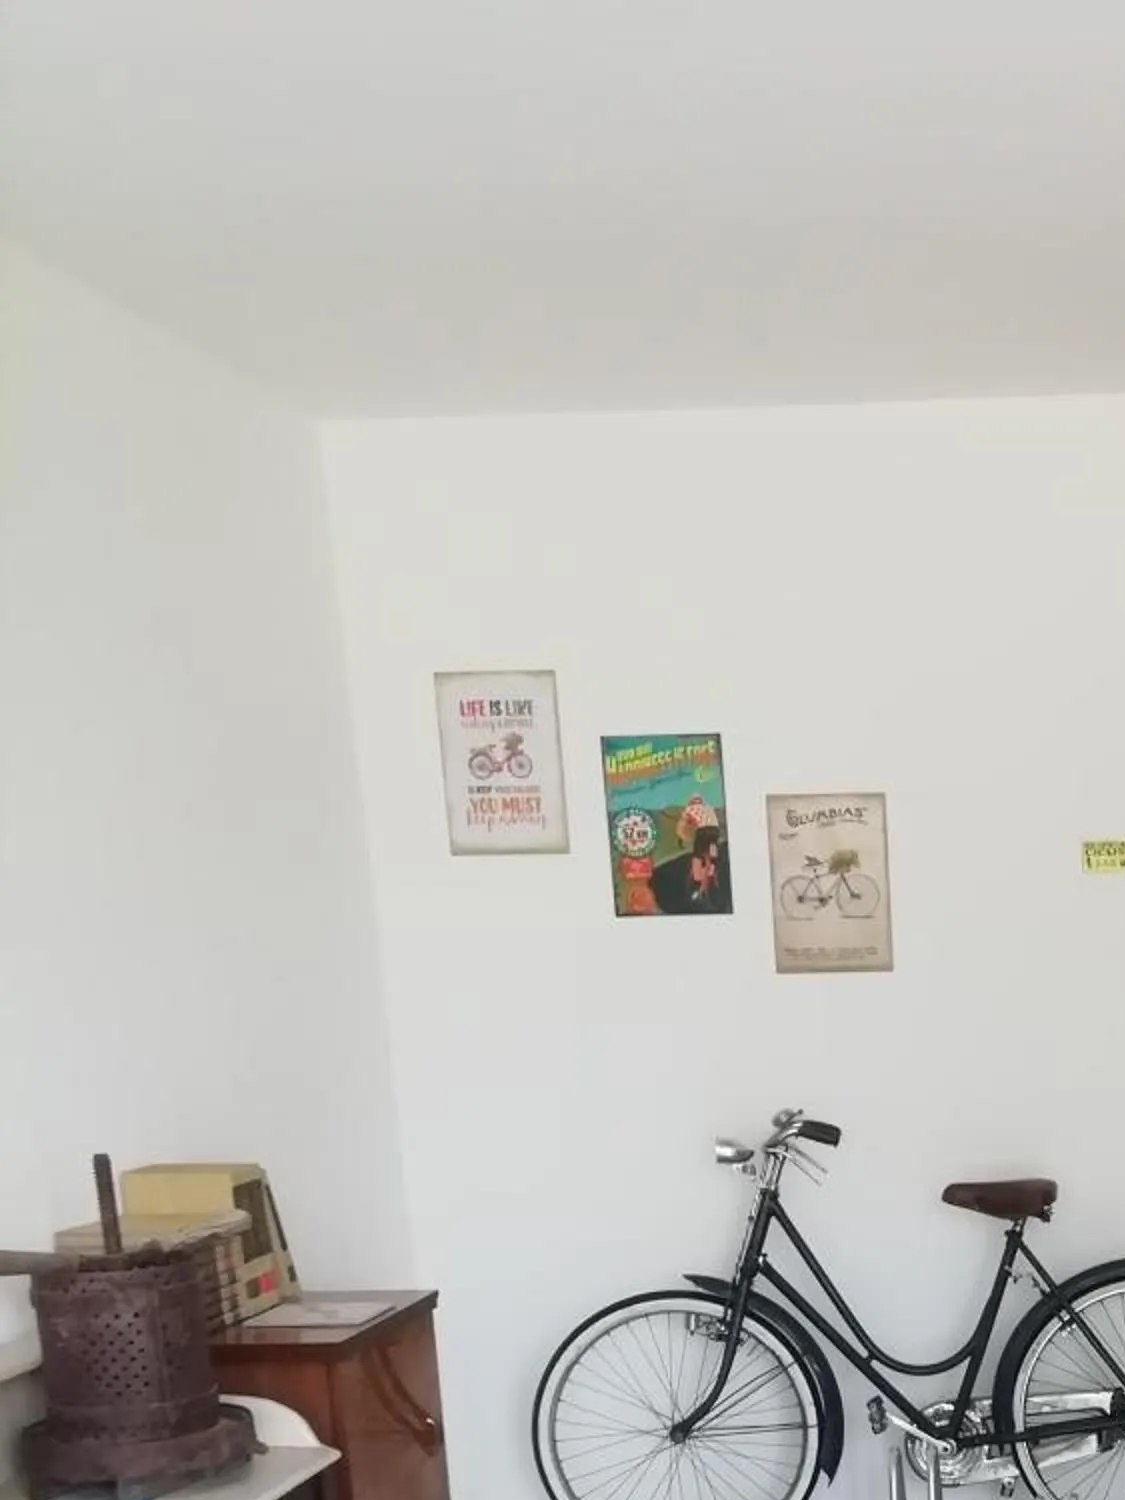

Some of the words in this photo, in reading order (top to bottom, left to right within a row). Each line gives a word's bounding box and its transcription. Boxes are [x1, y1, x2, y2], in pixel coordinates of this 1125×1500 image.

[459, 699, 486, 717] LIFE
[489, 699, 502, 717] IS
[468, 797, 498, 814] YOU
[501, 796, 541, 814] MUST
